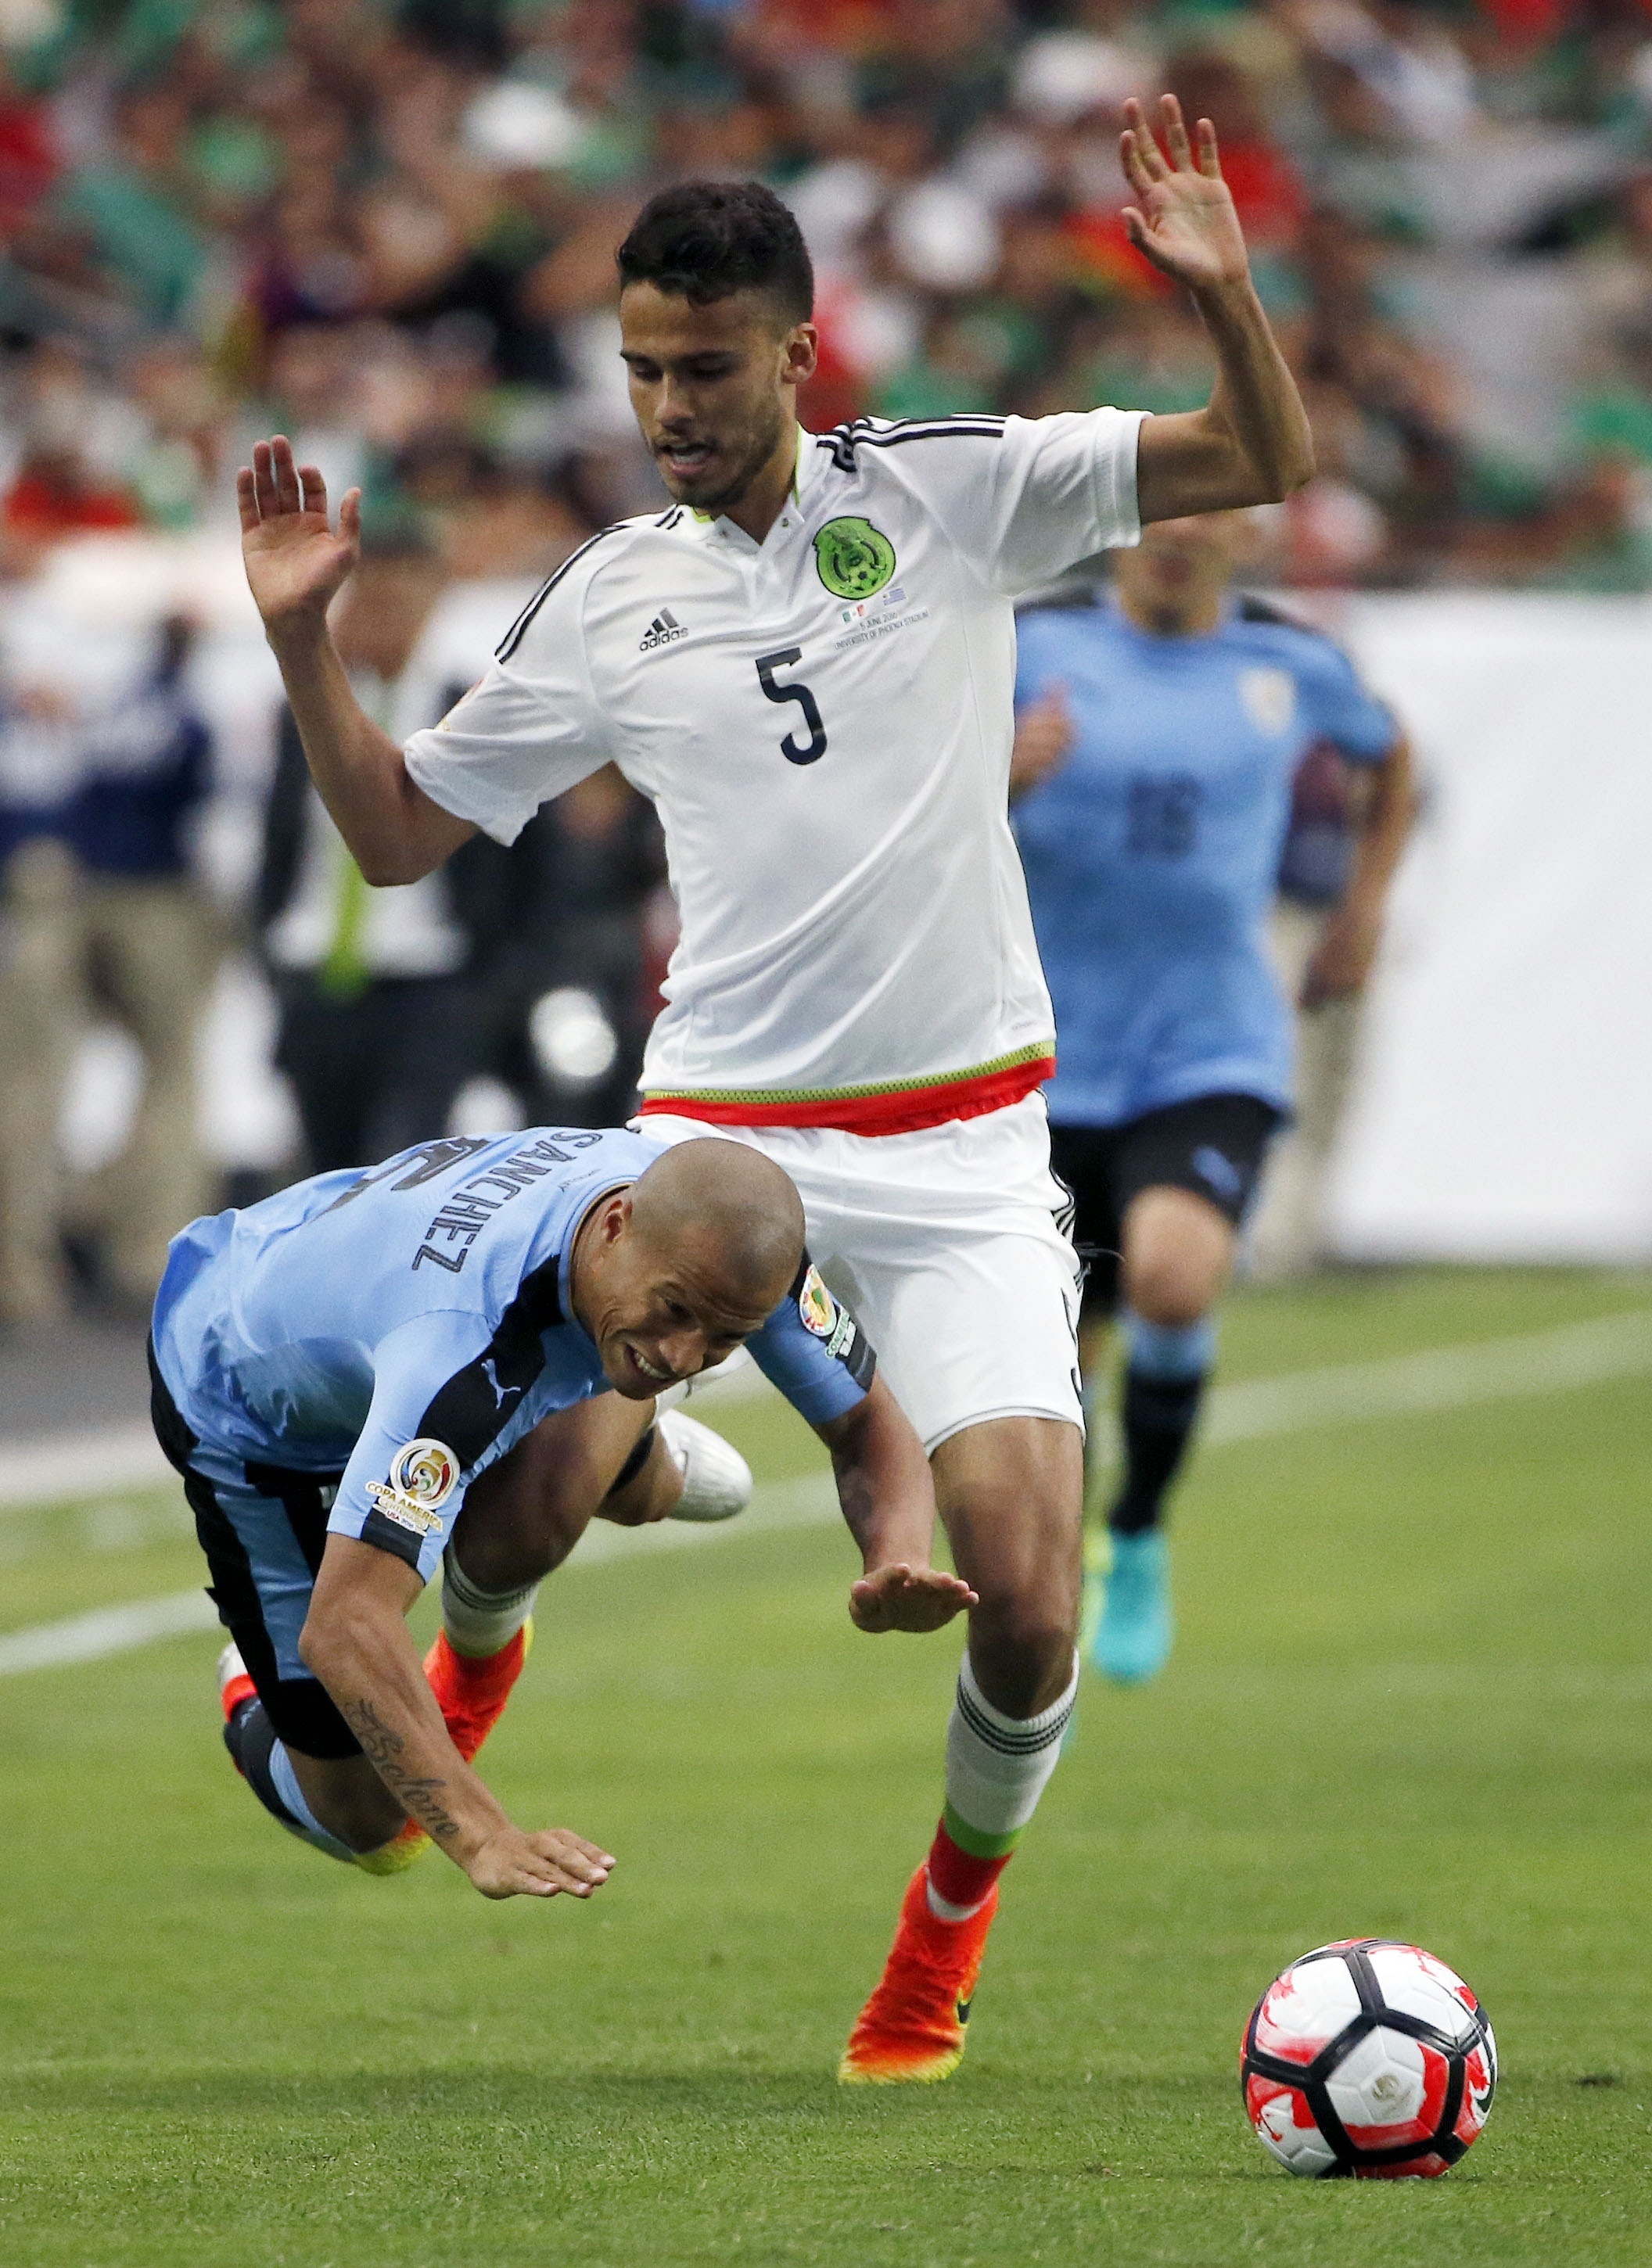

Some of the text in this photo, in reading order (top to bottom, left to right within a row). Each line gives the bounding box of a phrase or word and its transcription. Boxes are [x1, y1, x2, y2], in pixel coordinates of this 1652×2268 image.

[639, 627, 688, 651] adidas
[834, 632, 869, 650] UNIVERSITY
[755, 647, 828, 766] 5
[411, 1130, 603, 1273] SANCHEZ
[368, 1482, 442, 1529] COPA AMERICA
[387, 1509, 400, 1521] USA
